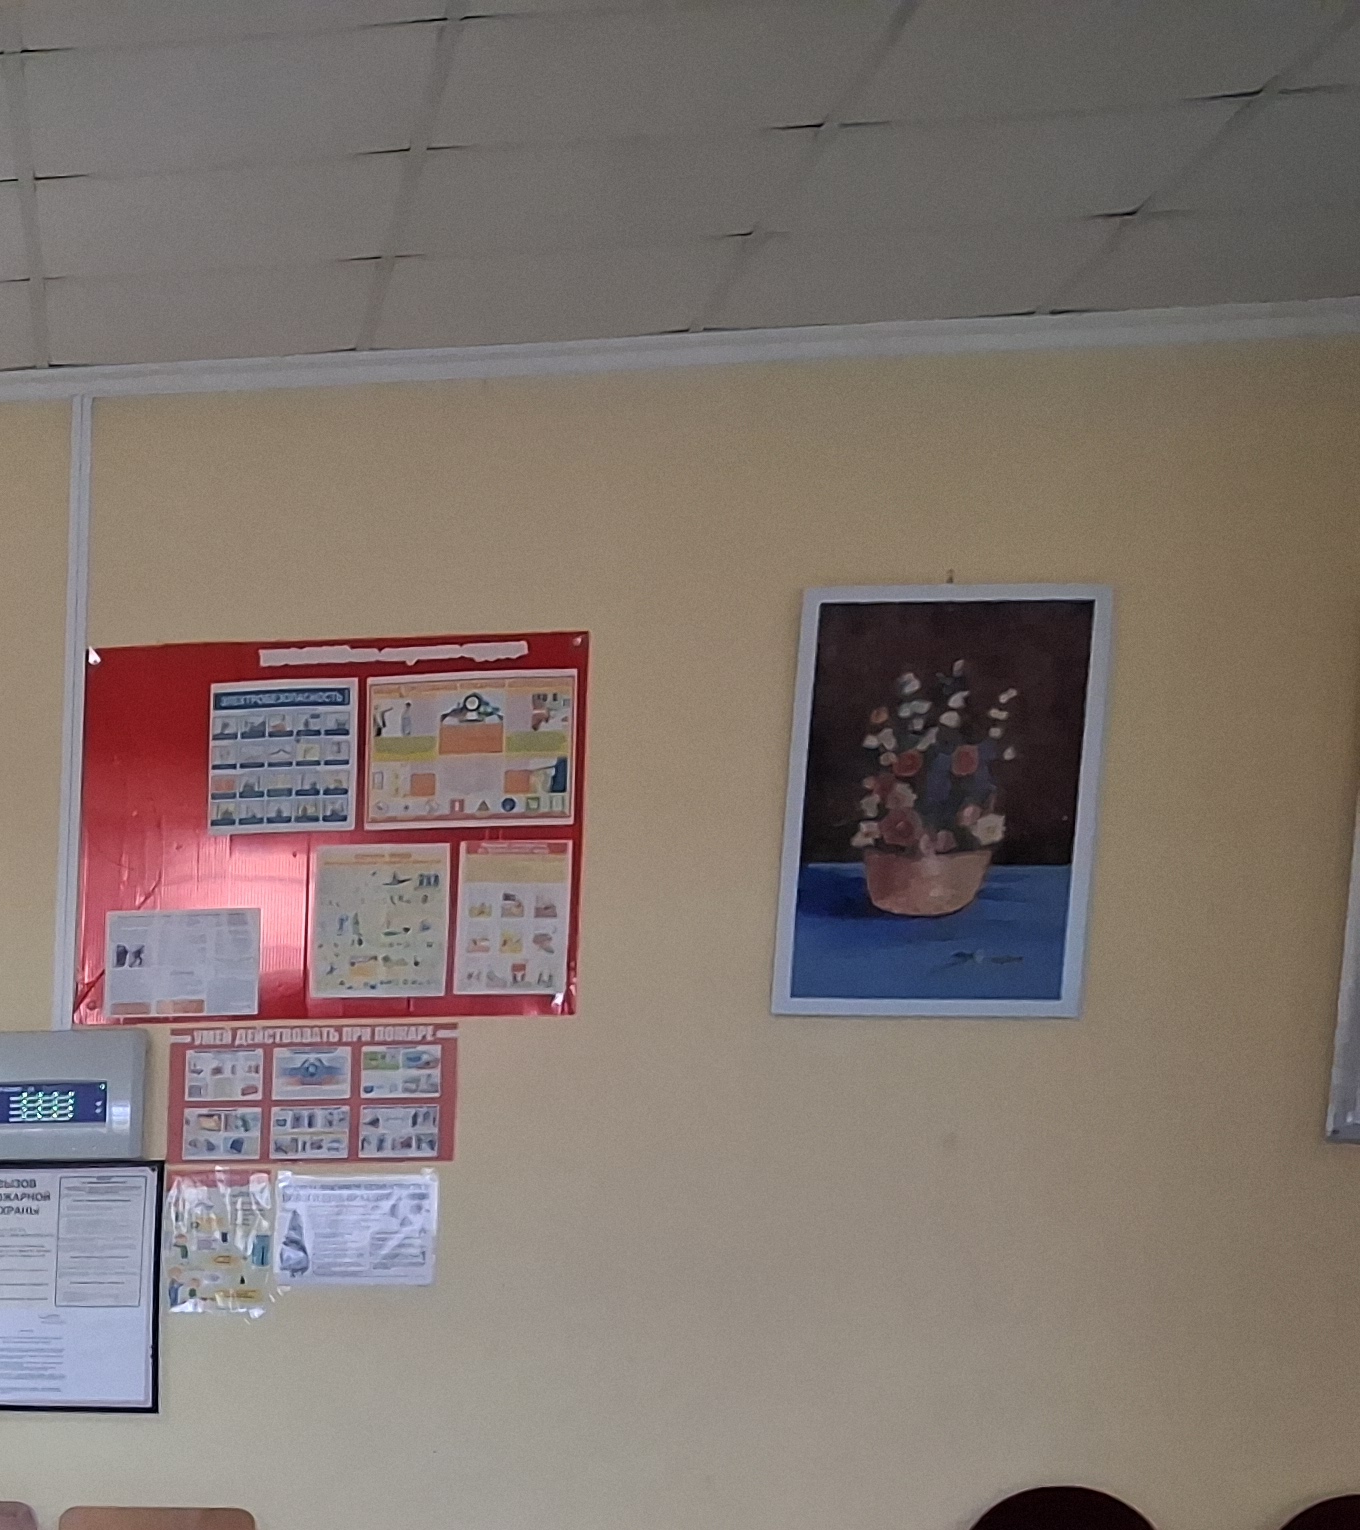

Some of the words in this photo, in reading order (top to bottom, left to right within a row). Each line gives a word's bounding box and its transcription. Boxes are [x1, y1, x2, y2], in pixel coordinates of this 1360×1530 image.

[194, 1028, 231, 1045] УМЕЙ
[234, 1026, 340, 1046] ДЕЙСТВОВАТЬ
[342, 1027, 372, 1042] ПРИ
[374, 1025, 435, 1041] ПОЖАРЕ
